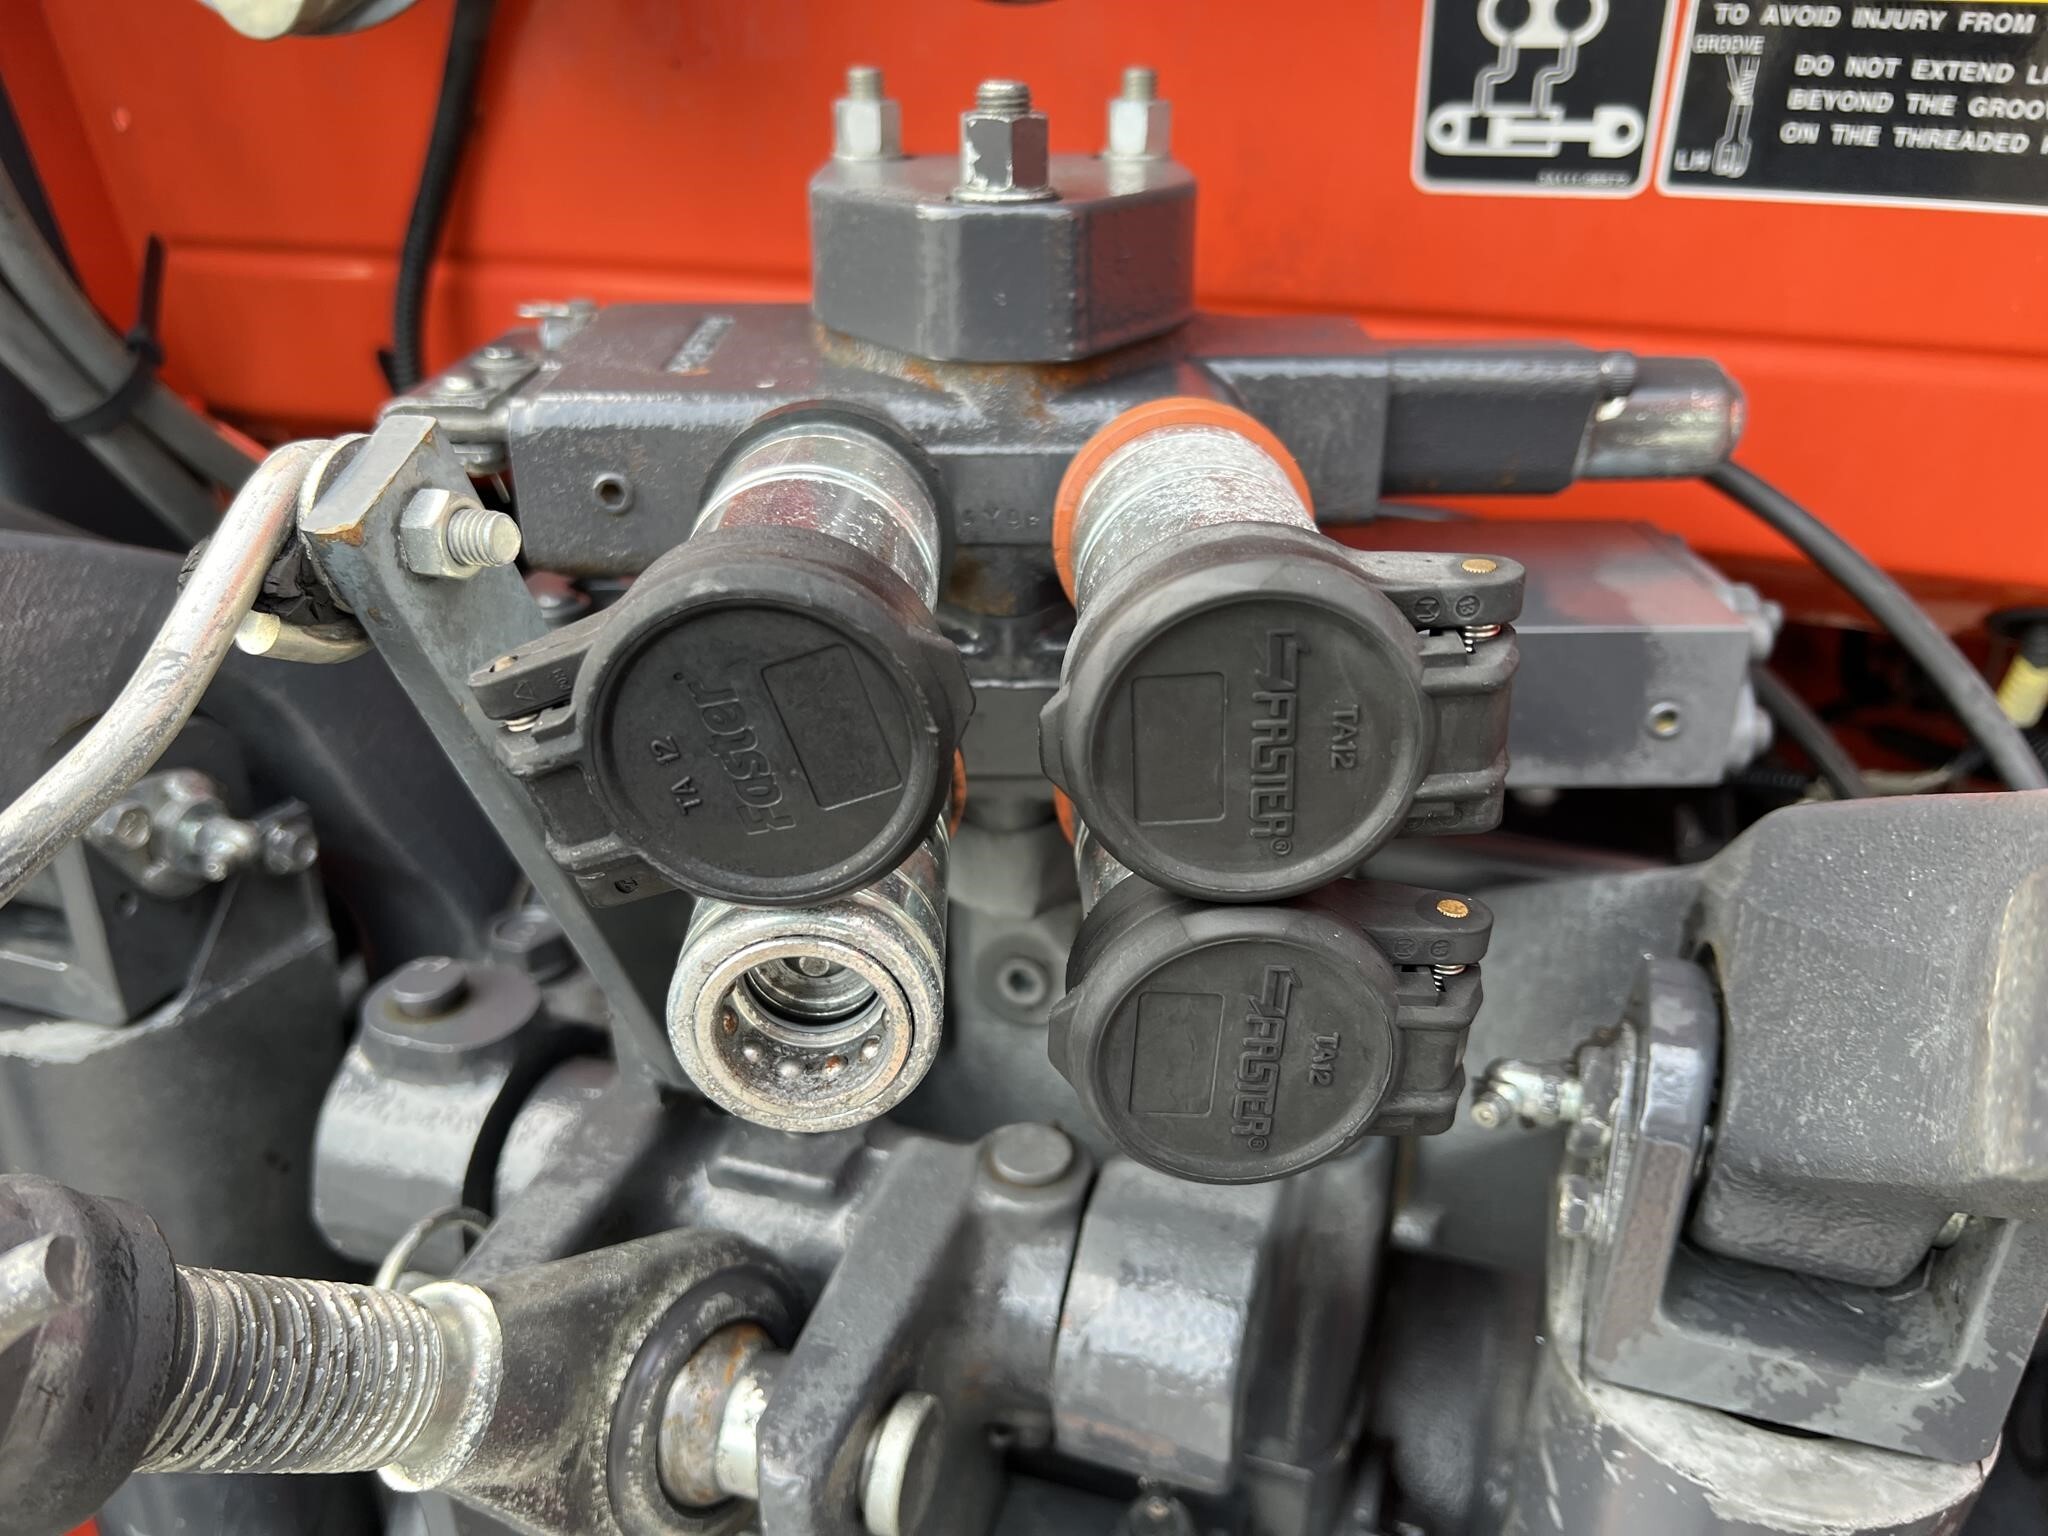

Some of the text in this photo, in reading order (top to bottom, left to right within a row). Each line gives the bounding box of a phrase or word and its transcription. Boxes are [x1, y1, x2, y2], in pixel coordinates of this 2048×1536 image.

[1714, 3, 2036, 34] TO AVOID INJURY FROM
[1693, 34, 1765, 55] GROOVE
[1795, 54, 1835, 77] DO
[1845, 56, 1902, 79] NOT
[1911, 58, 2015, 83] EXTEND
[1787, 88, 2048, 120] BEYOND THE GROO
[1780, 121, 1820, 144] ON
[1831, 123, 1882, 147] THE
[1893, 126, 2030, 153] THREADED
[1330, 704, 1361, 771] TA12
[650, 735, 703, 816] TA 12
[1309, 1031, 1341, 1087] TA12
